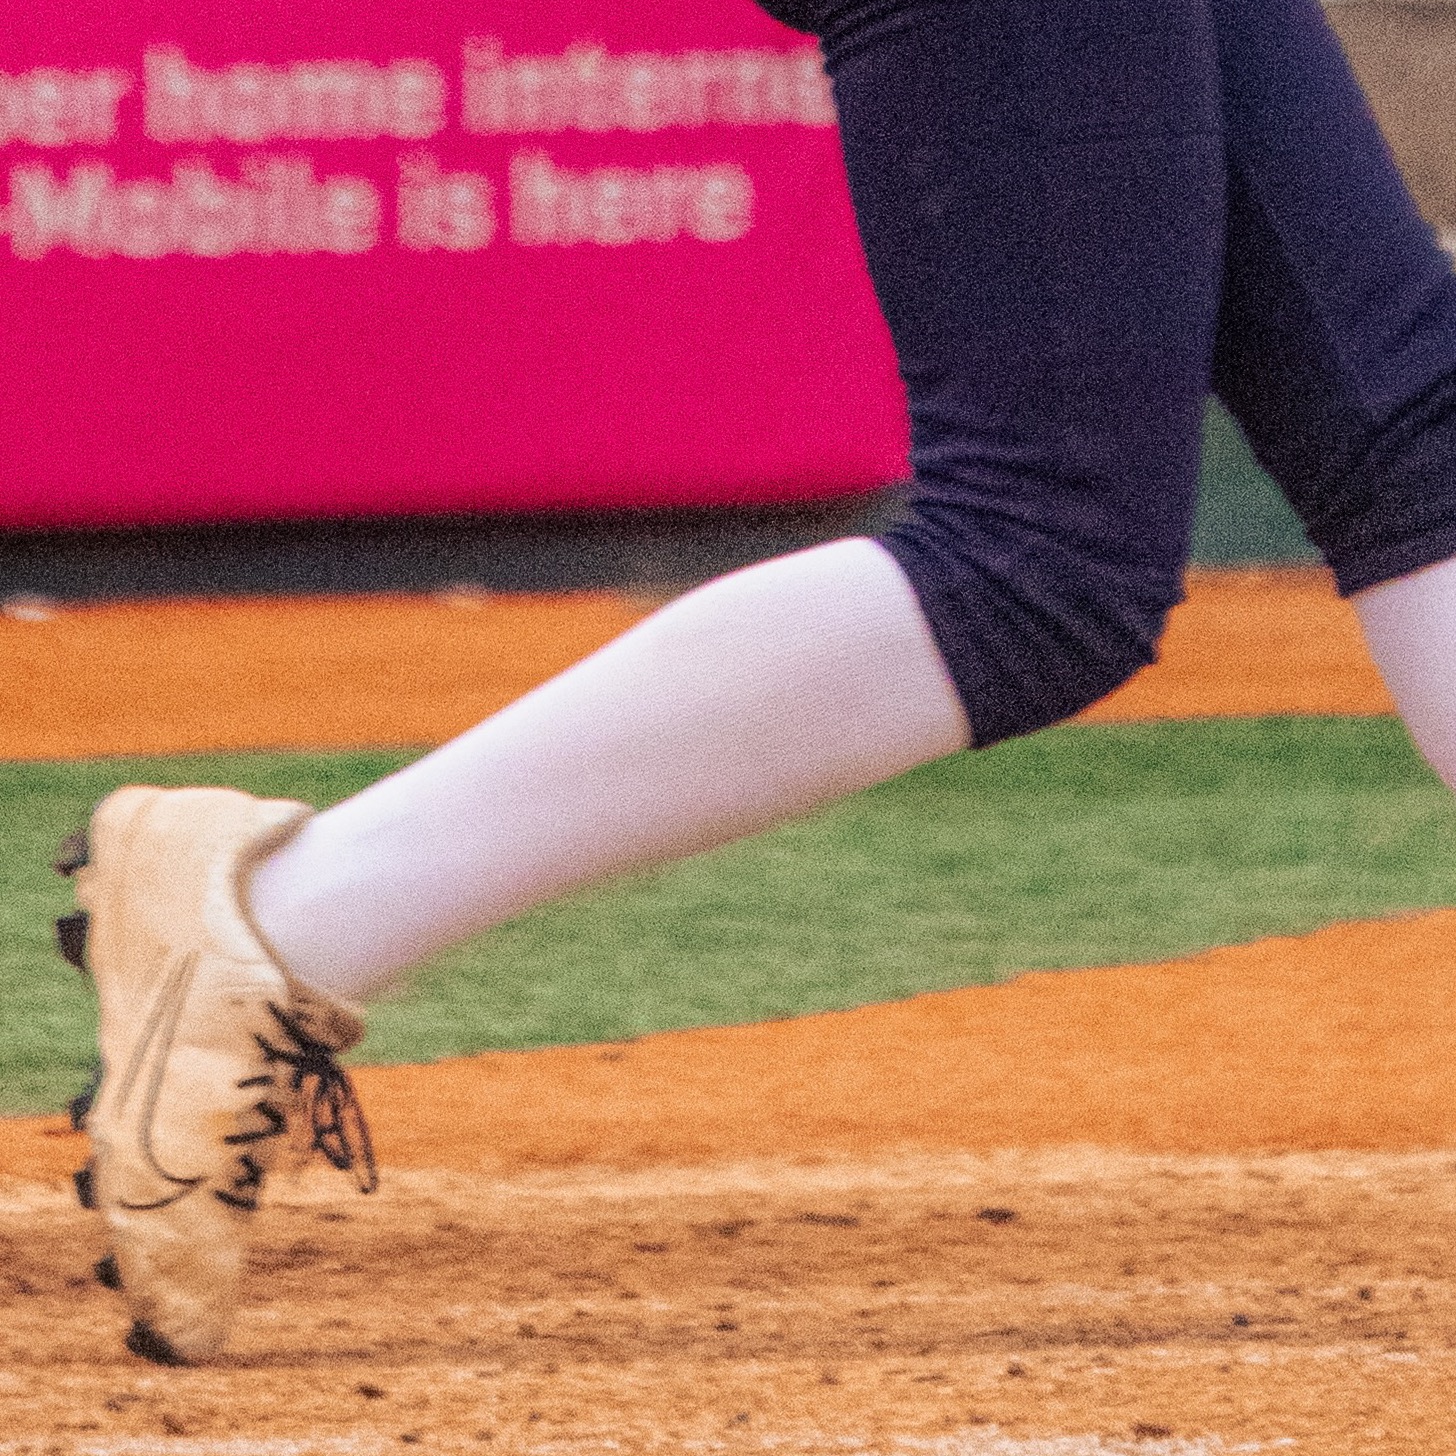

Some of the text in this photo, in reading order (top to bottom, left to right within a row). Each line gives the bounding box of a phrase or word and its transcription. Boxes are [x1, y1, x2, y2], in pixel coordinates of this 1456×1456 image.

[144, 44, 441, 142] home
[398, 151, 494, 251] is
[511, 150, 753, 244] here
